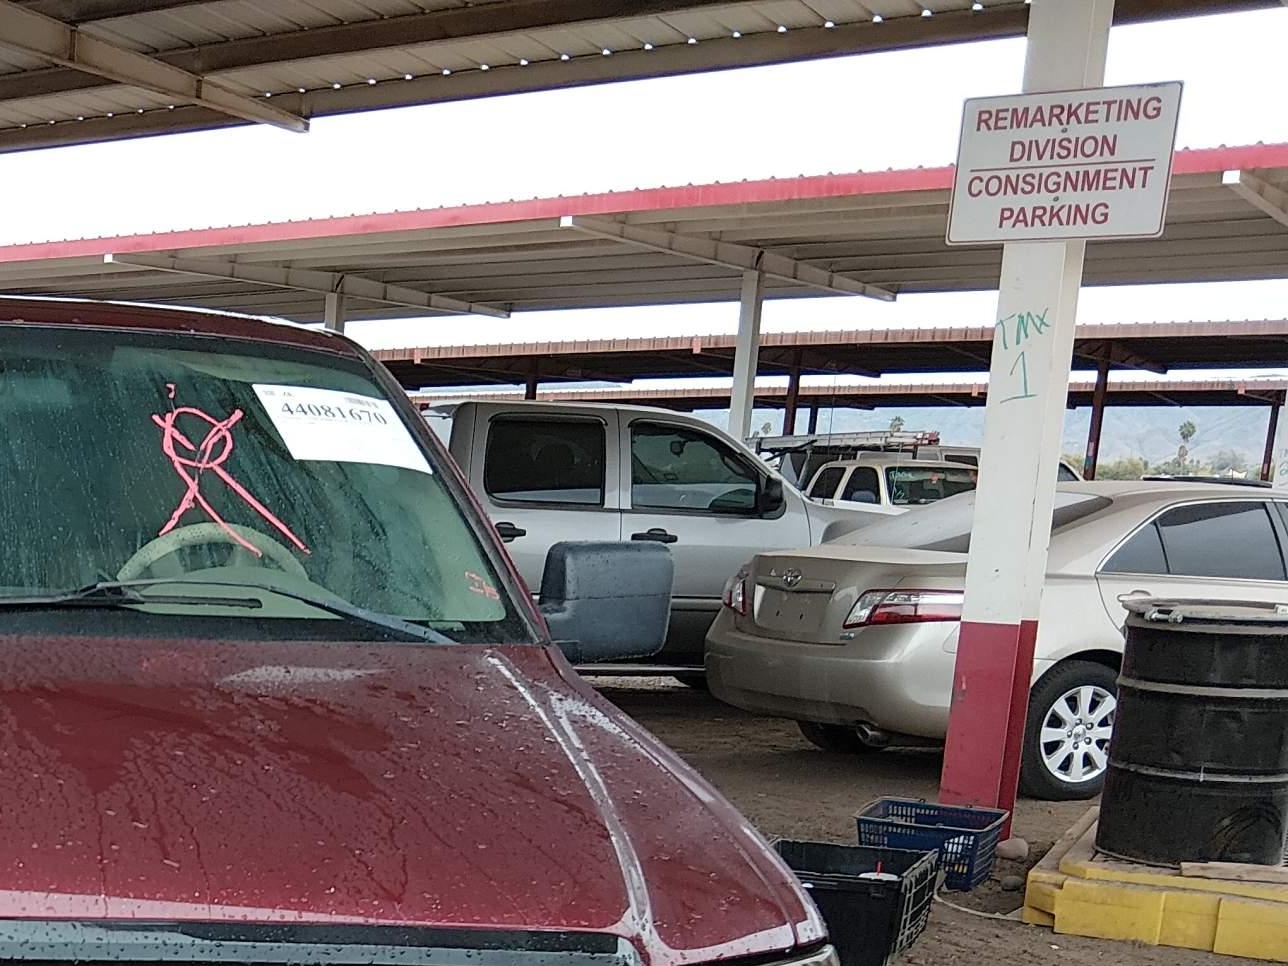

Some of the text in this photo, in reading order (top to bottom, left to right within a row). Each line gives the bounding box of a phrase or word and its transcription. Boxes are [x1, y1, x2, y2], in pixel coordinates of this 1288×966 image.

[976, 96, 1161, 132] REMARKETING
[1009, 135, 1118, 163] DIVISION
[968, 166, 1154, 198] CONSIGNMENT
[998, 202, 1110, 229] PARKING
[281, 402, 388, 425] 44081670
